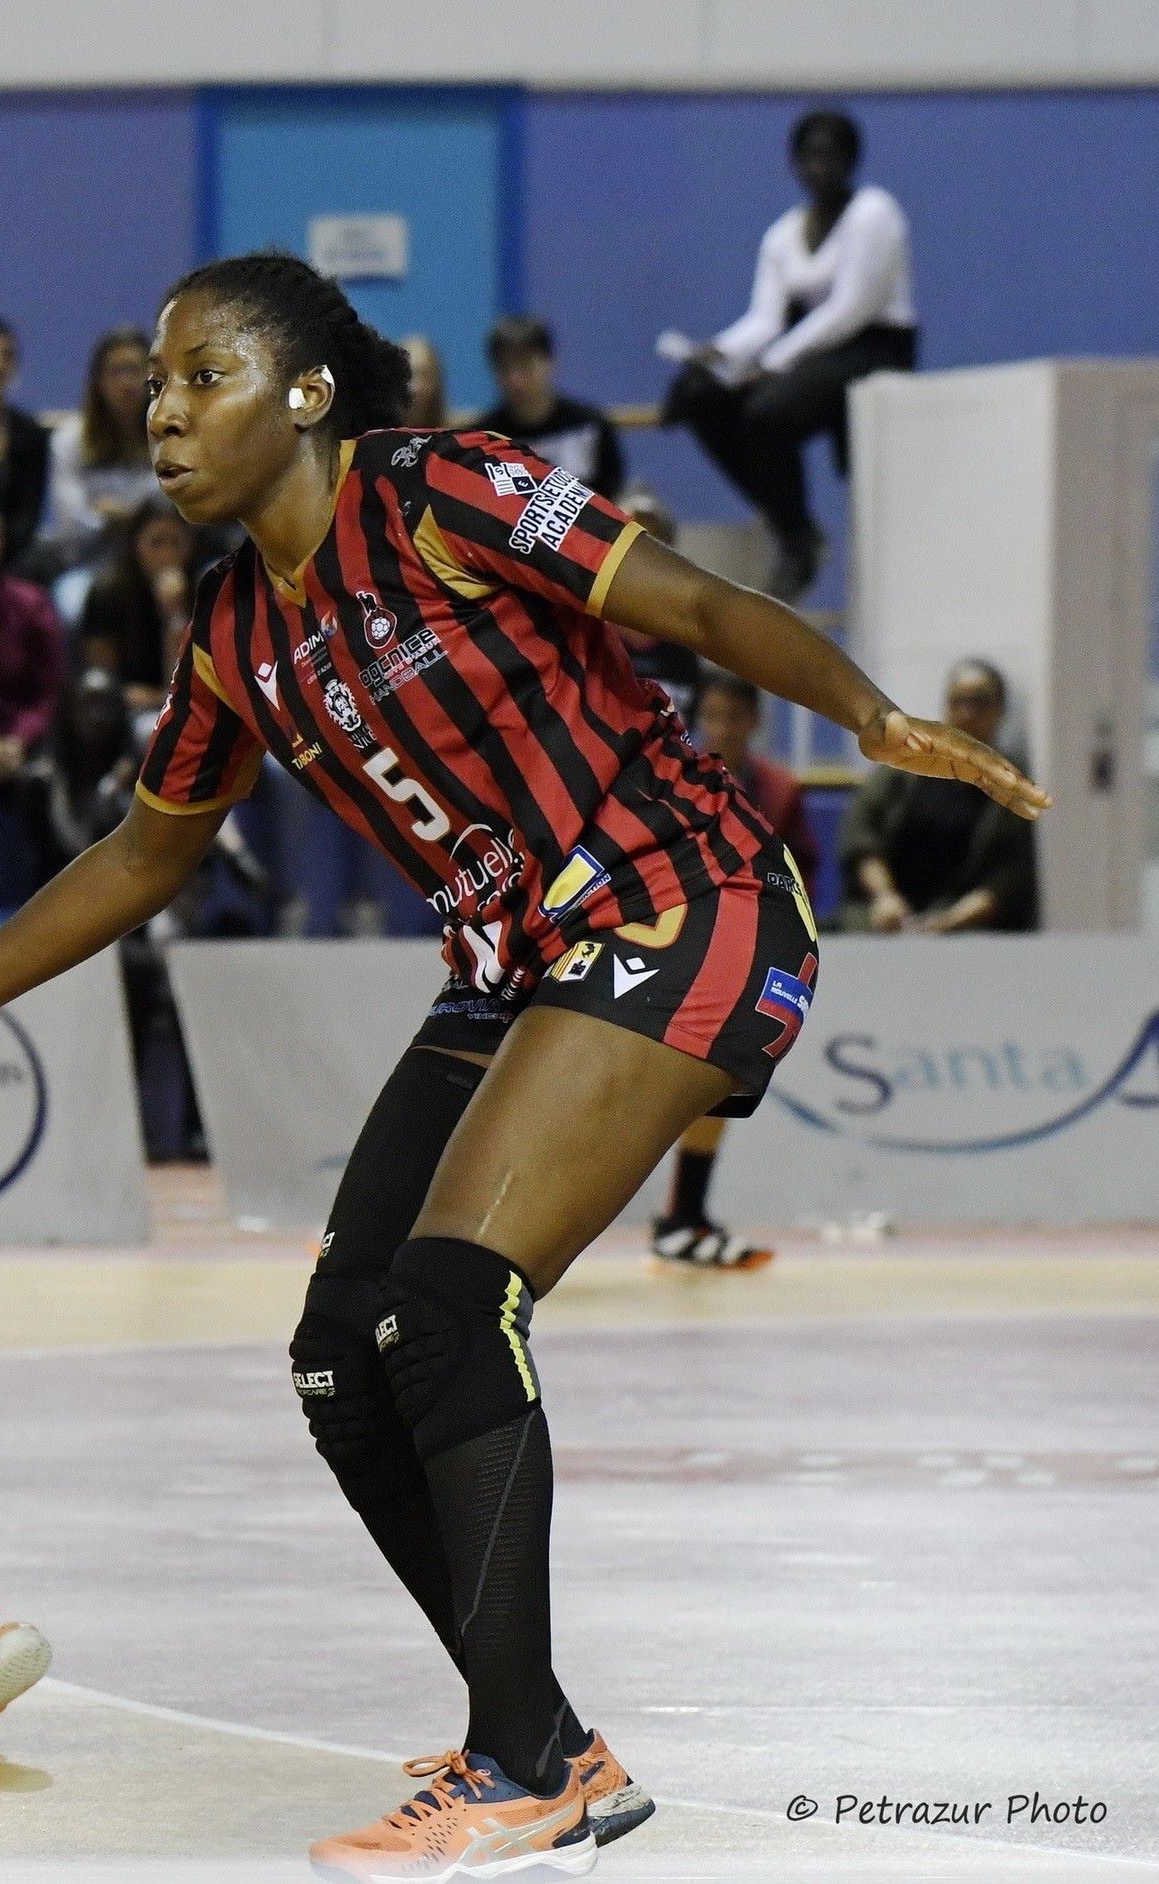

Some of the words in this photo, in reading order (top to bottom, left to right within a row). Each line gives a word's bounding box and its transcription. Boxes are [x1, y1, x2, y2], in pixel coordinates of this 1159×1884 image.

[294, 631, 325, 664] ADIM
[292, 741, 322, 770] TABONI
[362, 747, 451, 842] 5
[824, 1032, 1090, 1116] Santa
